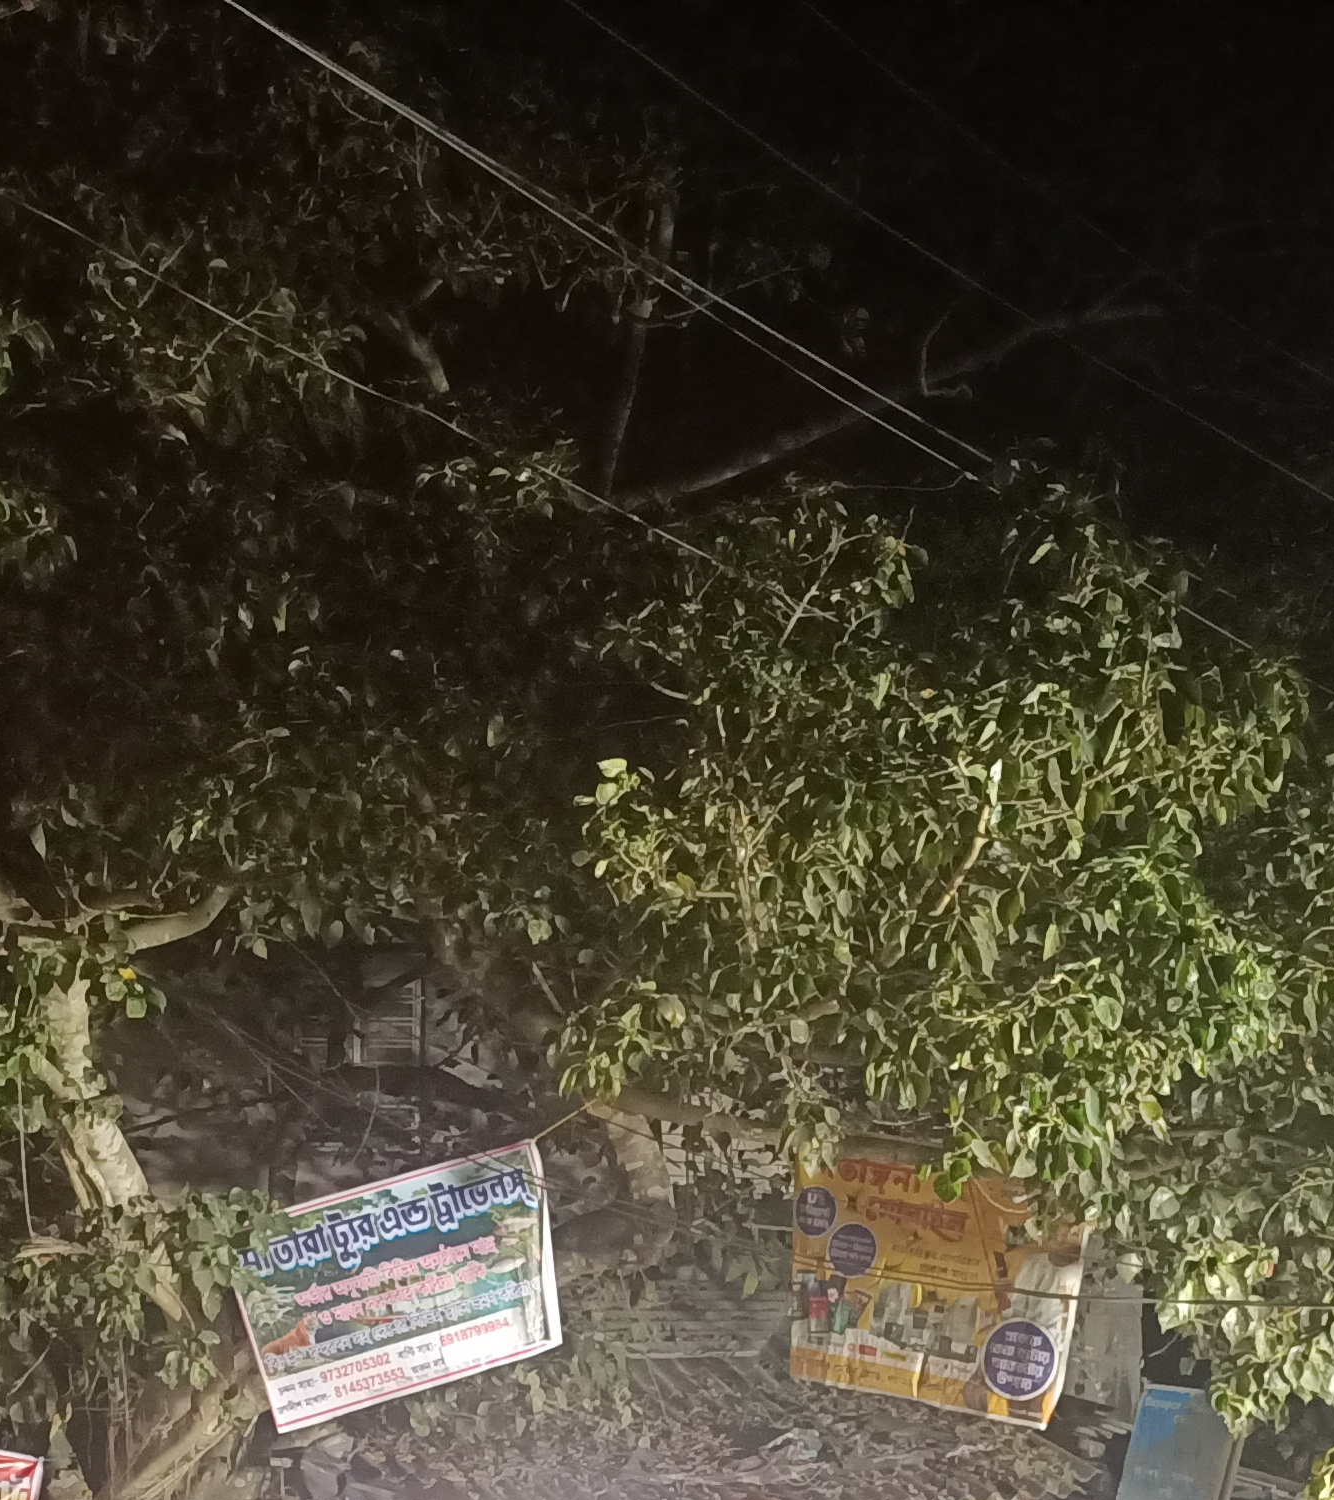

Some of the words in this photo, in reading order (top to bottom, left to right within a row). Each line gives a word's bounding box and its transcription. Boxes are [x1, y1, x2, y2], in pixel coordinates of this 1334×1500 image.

[269, 1222, 328, 1263] তারা
[320, 1352, 392, 1384] 9732705302
[334, 1368, 406, 1398] 8145373553
